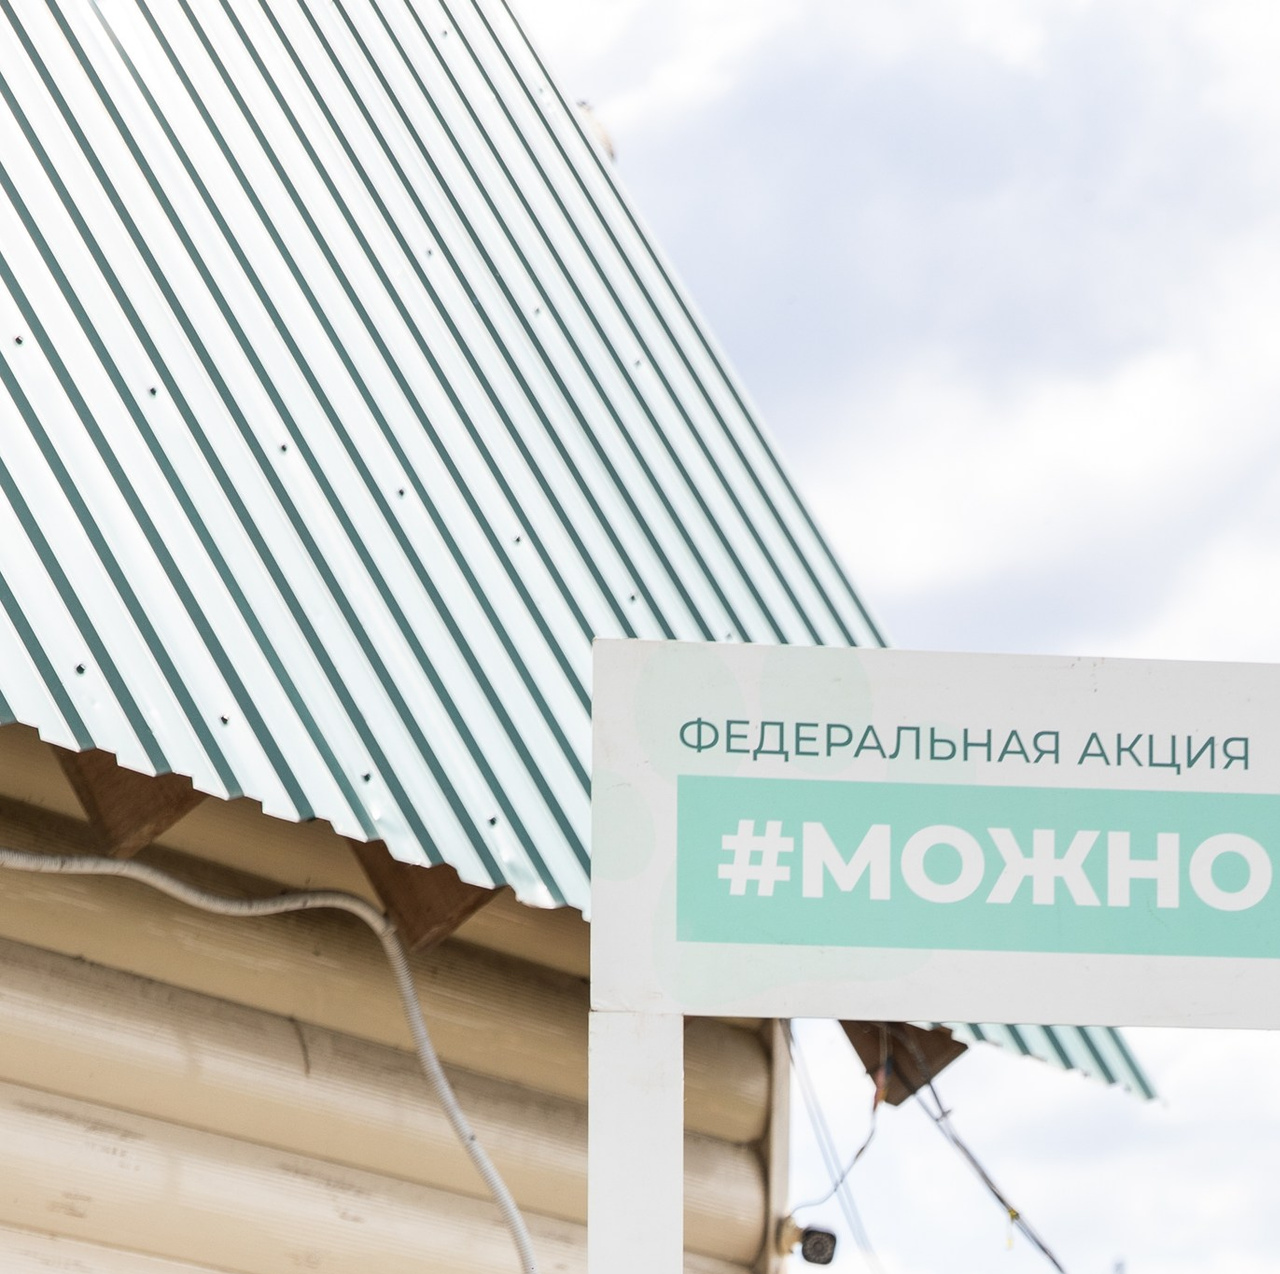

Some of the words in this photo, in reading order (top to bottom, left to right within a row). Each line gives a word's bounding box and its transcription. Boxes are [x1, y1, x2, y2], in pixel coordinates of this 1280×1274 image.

[680, 717, 1060, 766] ФЕДЕРАЛЬНАЯ
[1077, 732, 1249, 775] АКЦИЯ
[717, 819, 1273, 912] #МОЖНО
